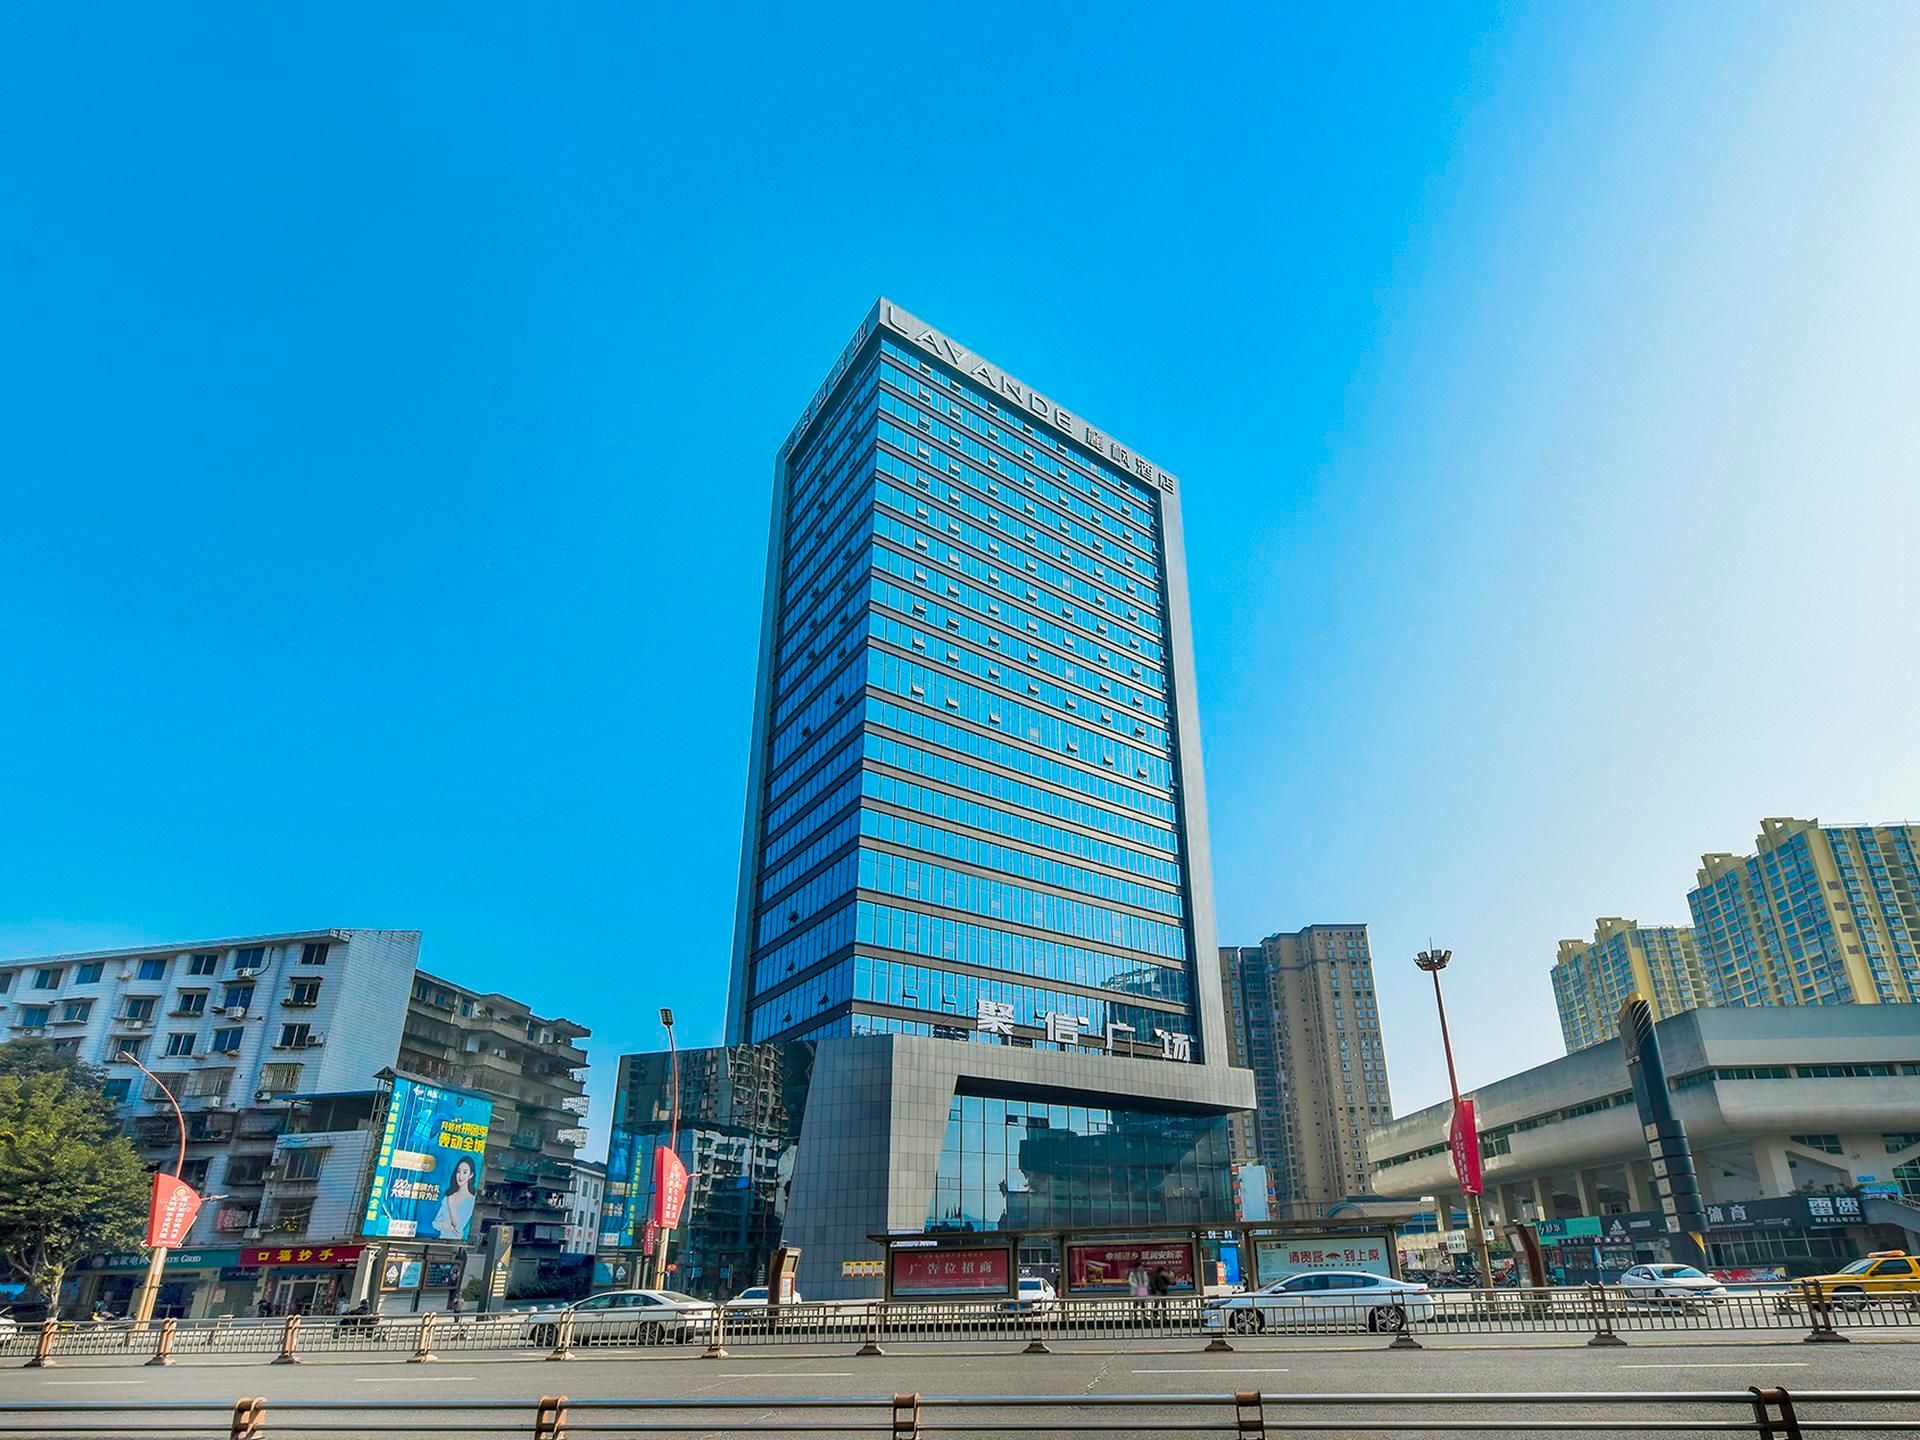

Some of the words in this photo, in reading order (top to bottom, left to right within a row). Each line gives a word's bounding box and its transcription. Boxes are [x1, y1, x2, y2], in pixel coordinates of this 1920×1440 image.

[889, 305, 1073, 434] LAVANDE
[977, 999, 1192, 1062] 聚信广场
[257, 1248, 335, 1262] 口福抄手
[908, 1260, 993, 1275] 广告位招商
